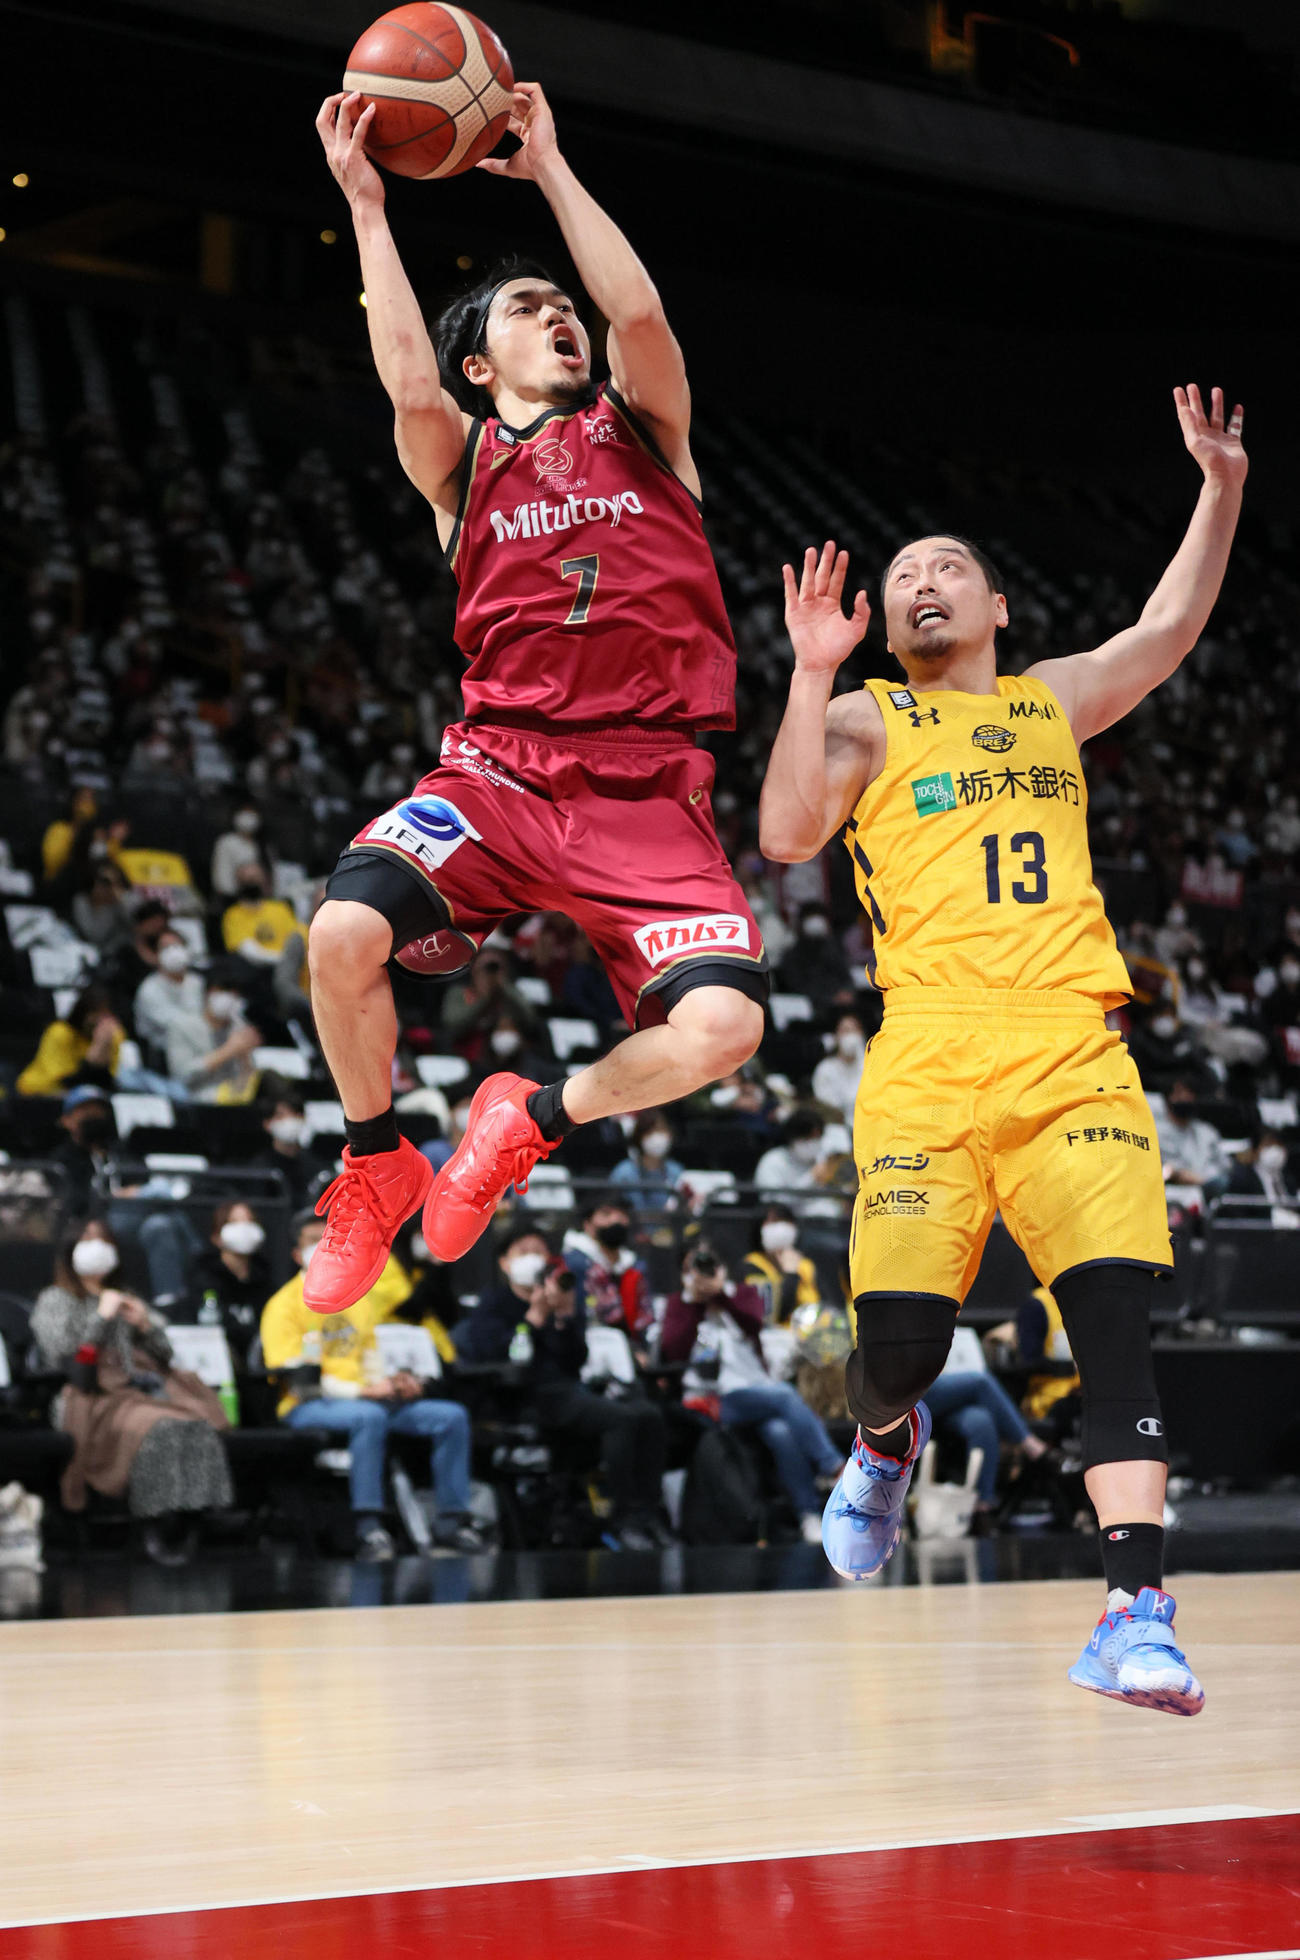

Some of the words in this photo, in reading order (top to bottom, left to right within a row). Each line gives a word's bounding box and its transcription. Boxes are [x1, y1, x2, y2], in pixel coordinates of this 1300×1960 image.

[489, 490, 644, 543] Mitutoyo
[560, 553, 599, 624] 7
[972, 732, 1017, 747] BREX
[485, 768, 525, 794] THUNDERS
[956, 766, 1079, 806] 栃木銀行
[980, 831, 1049, 904] 13
[643, 920, 740, 958] オカムラ
[1057, 1126, 1150, 1151] 下野新聞
[864, 1190, 930, 1212] ALMEX
